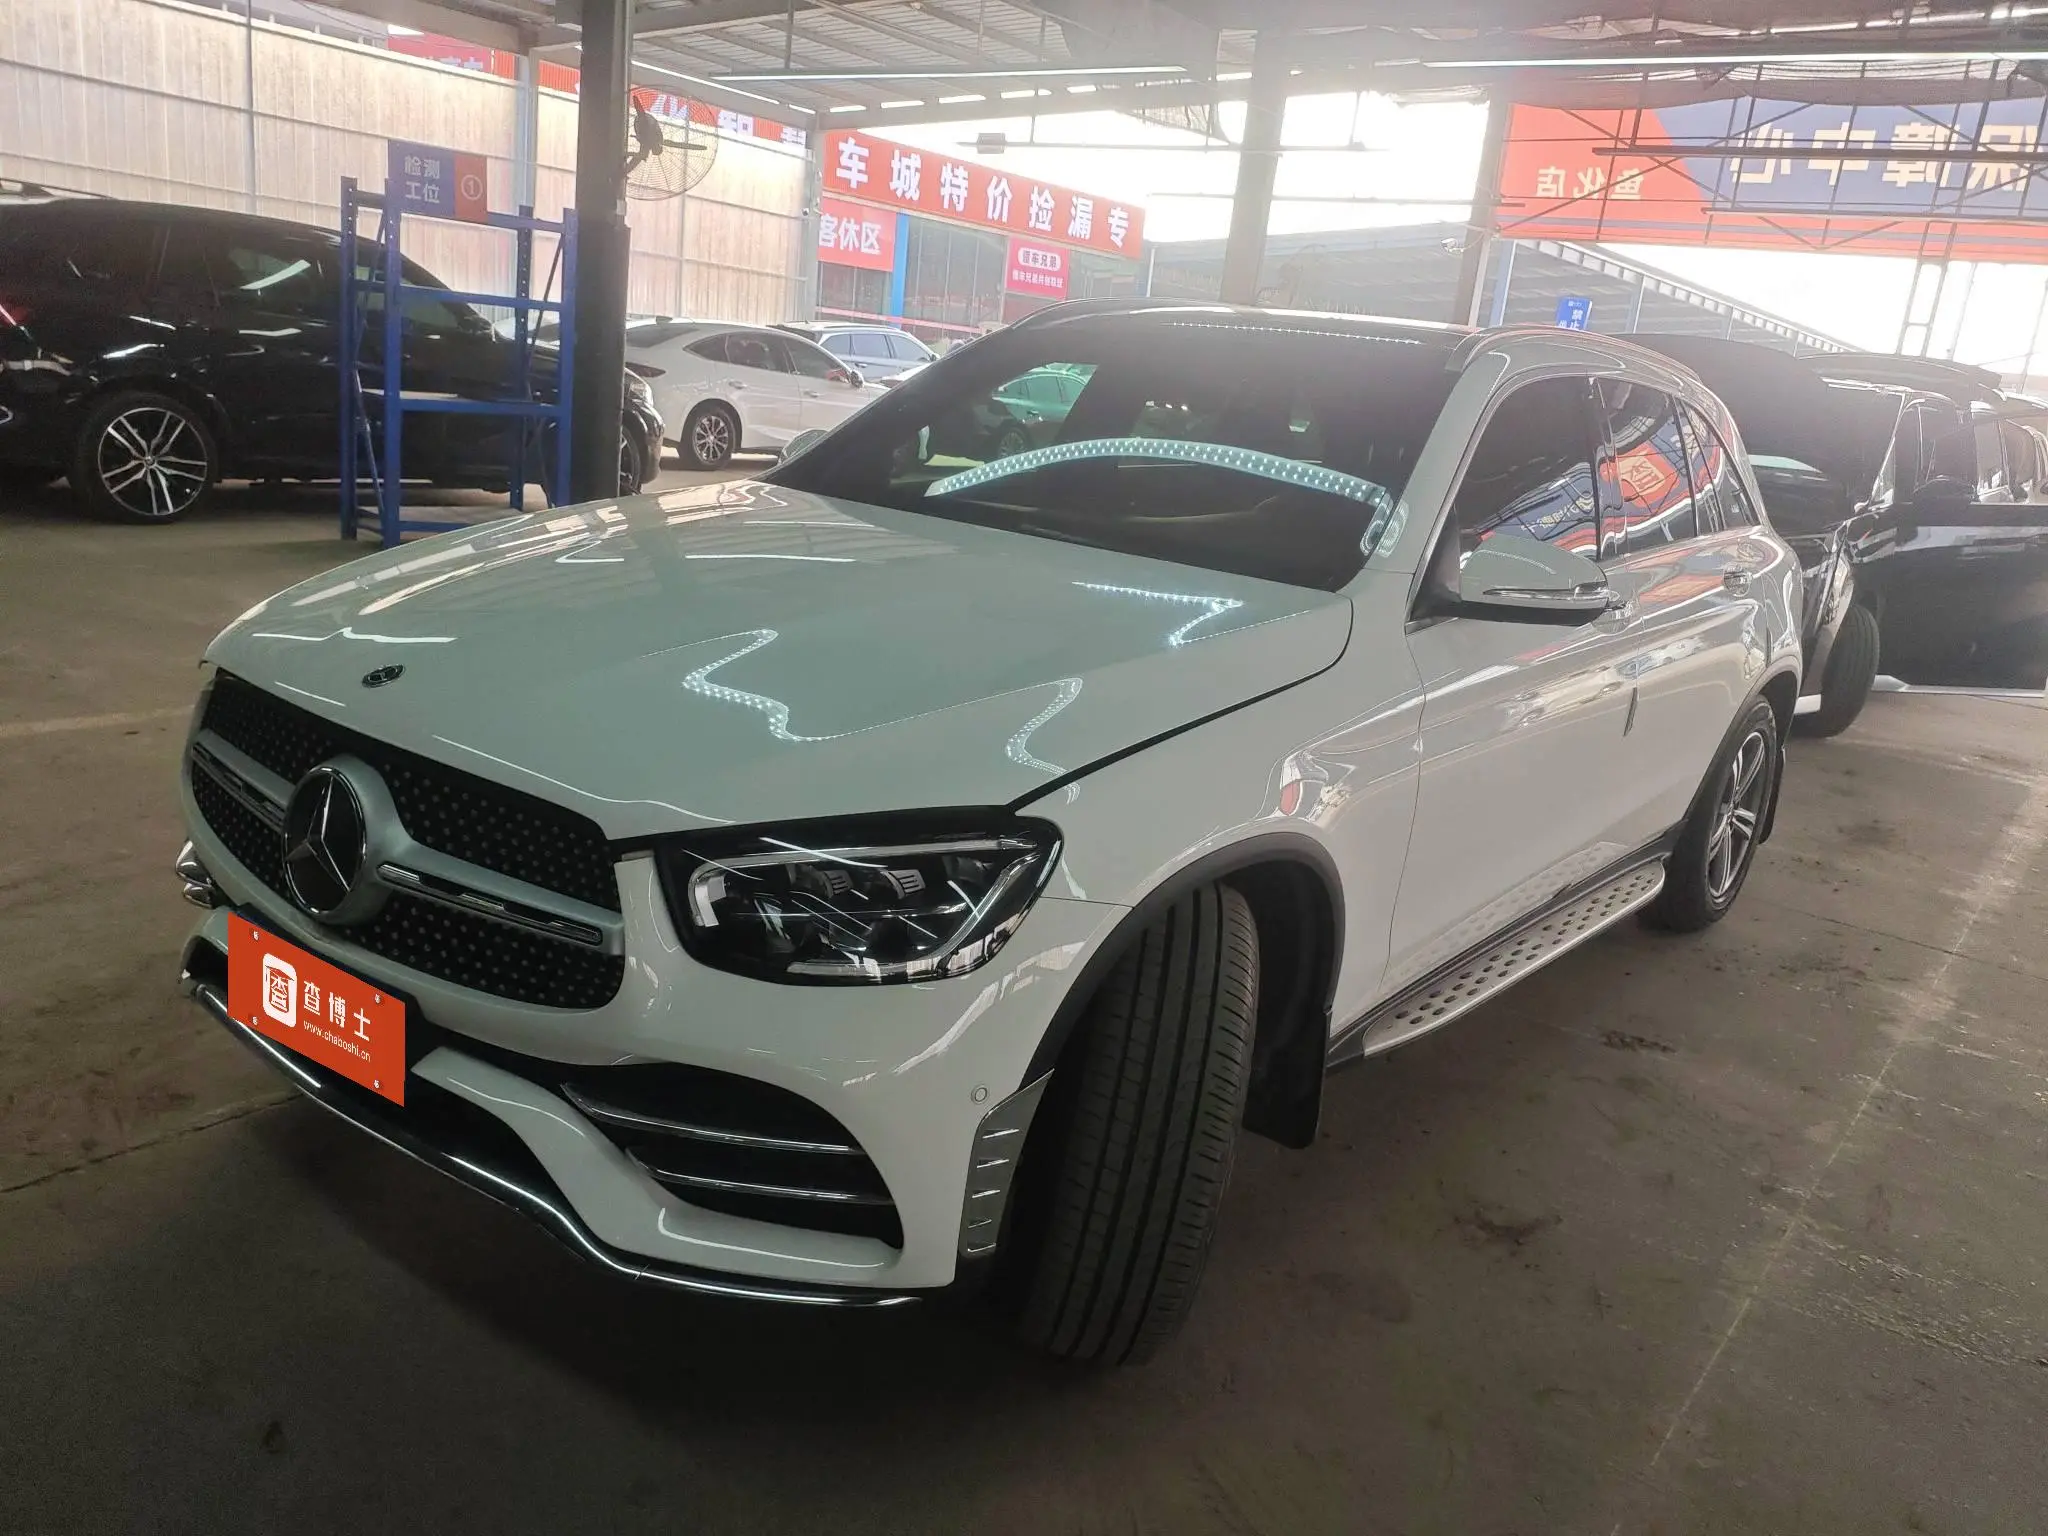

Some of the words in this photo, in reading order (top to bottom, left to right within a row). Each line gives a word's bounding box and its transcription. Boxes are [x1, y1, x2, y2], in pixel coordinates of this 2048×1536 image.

[404, 155, 440, 179] 检测
[405, 181, 440, 203] 工位
[836, 137, 1129, 248] 车城特价捡漏专
[818, 213, 882, 255] 客休区
